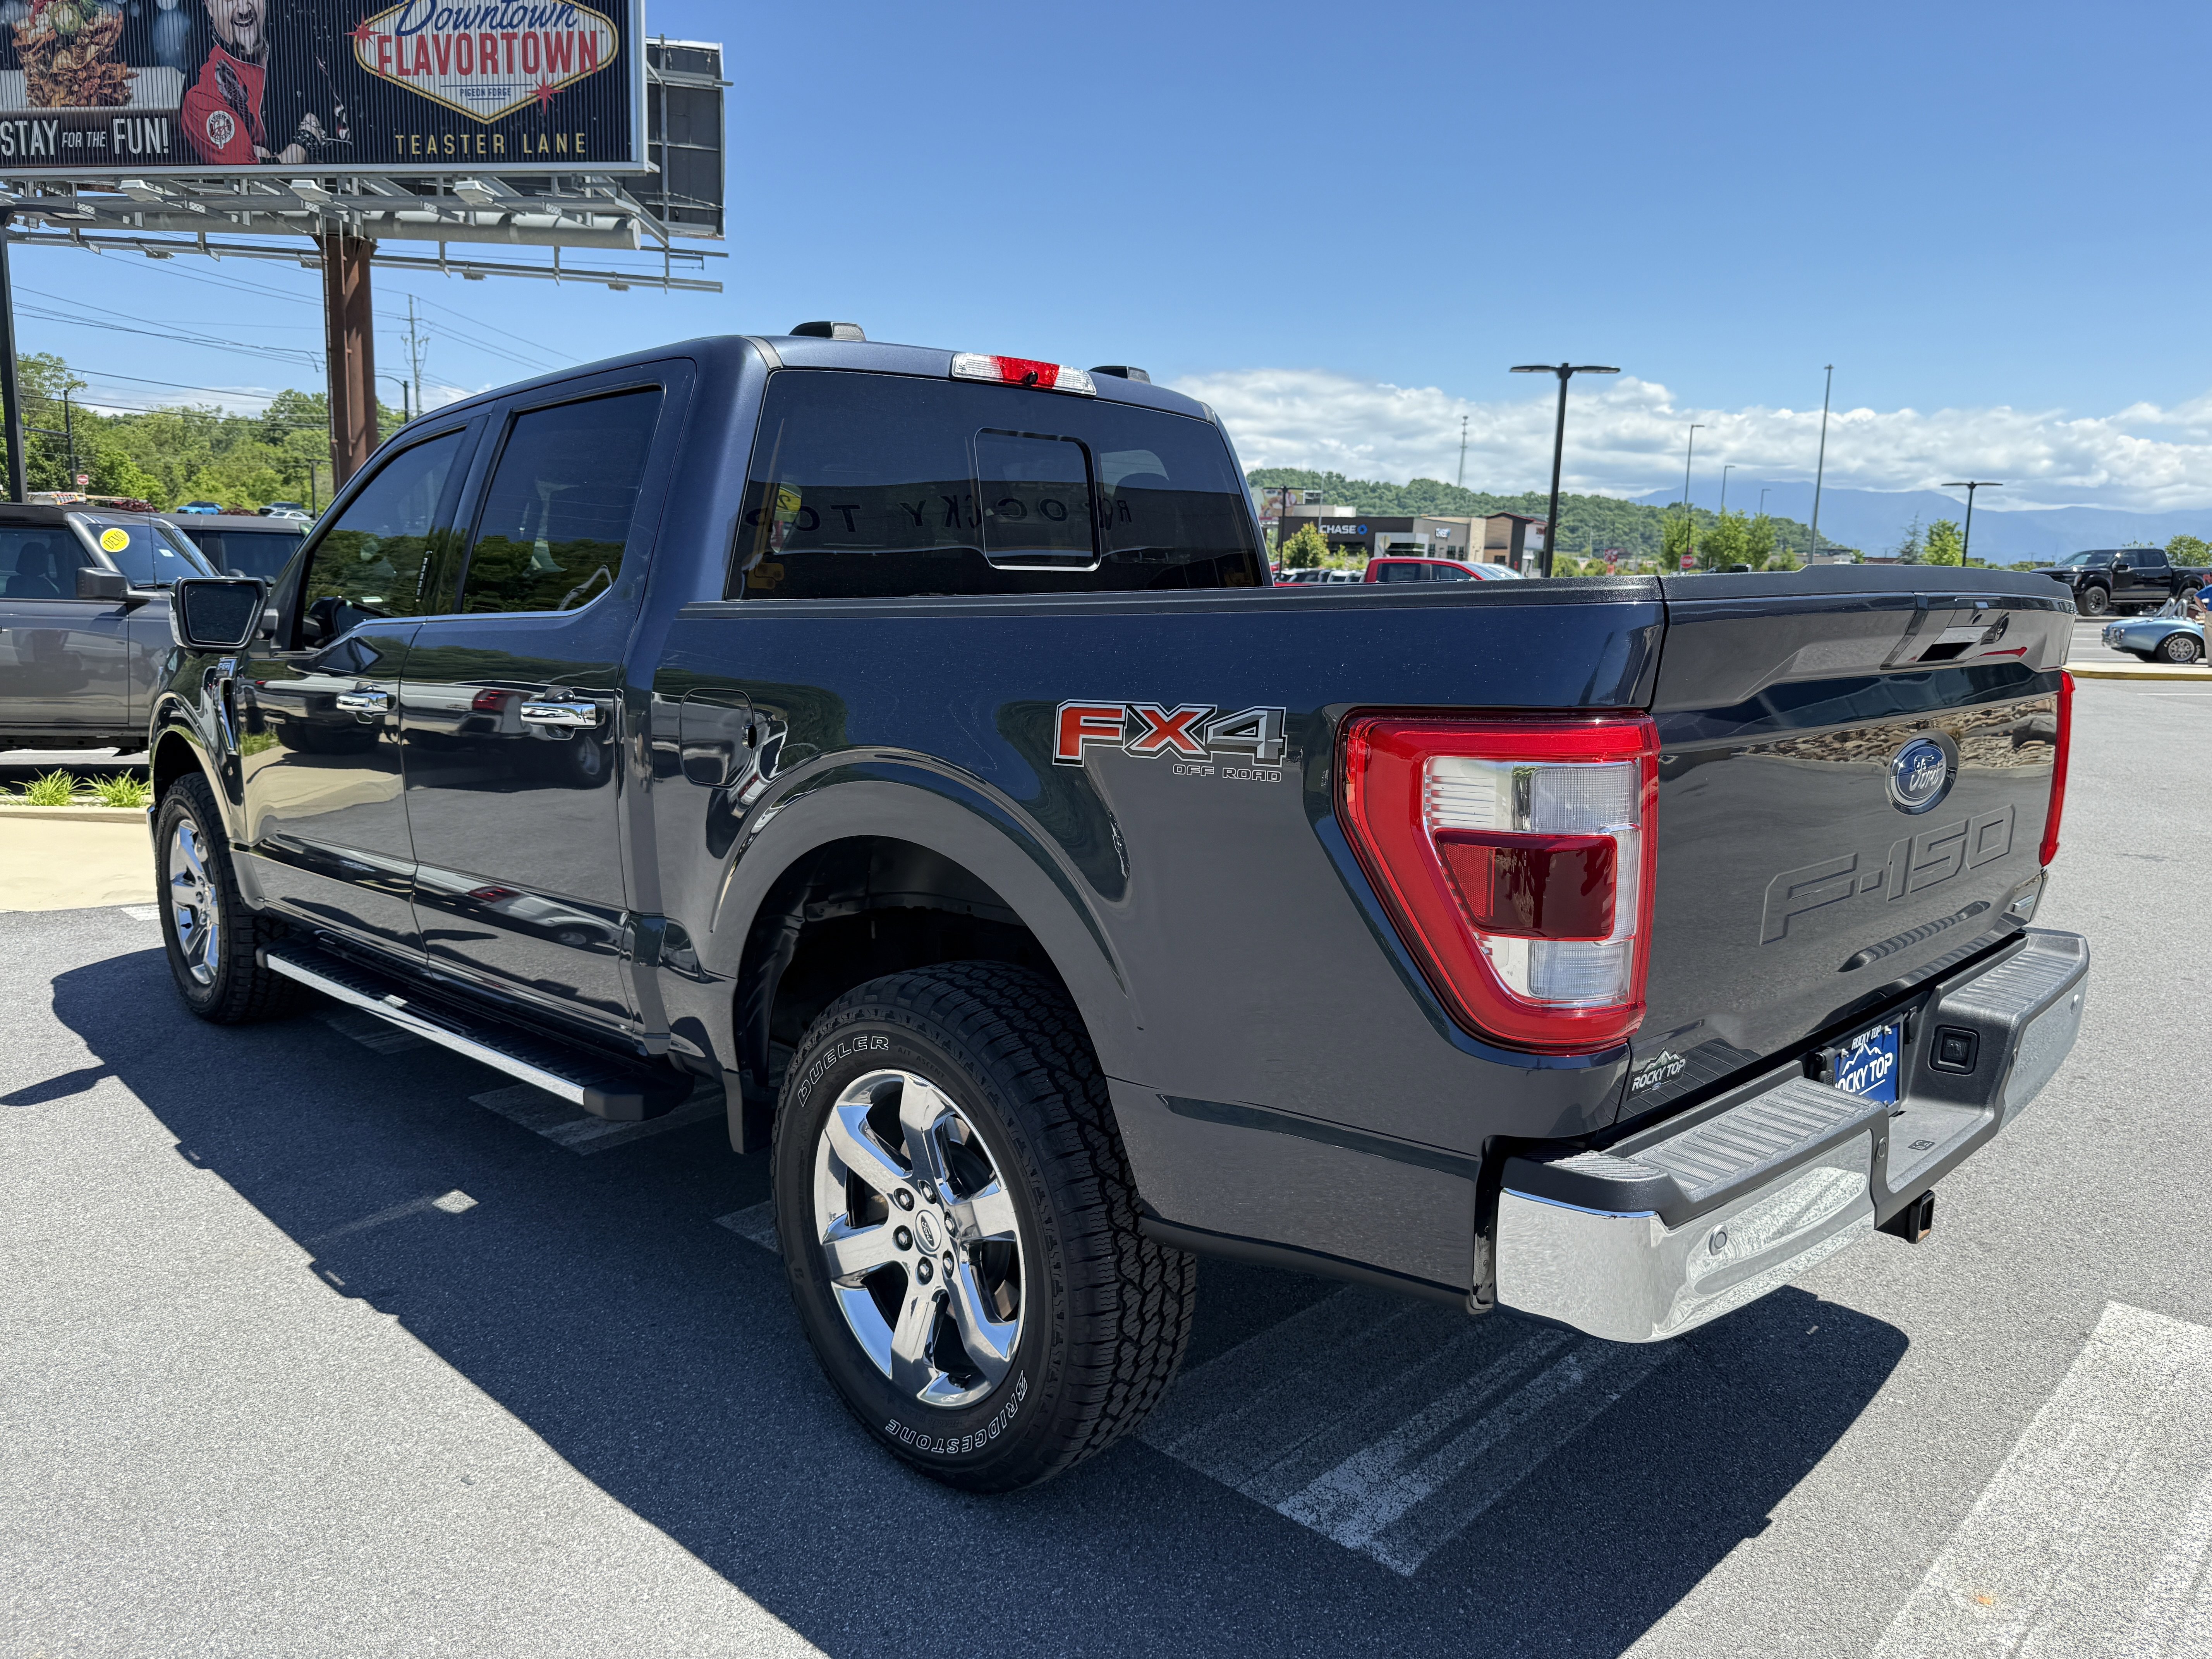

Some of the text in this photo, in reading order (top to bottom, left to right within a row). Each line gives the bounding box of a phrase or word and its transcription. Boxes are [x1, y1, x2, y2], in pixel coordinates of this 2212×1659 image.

[396, 0, 577, 36] Downtown
[377, 30, 598, 76] FLAVORTOWN
[460, 87, 511, 97] PIGEON FORGE
[0, 118, 169, 156] STAY FOR THE FUN!
[395, 133, 586, 155] TEASTER LANE
[102, 531, 126, 549] DEMO
[1320, 525, 1357, 534] CHASE
[1053, 699, 1288, 768] FX4
[1173, 764, 1282, 782] OFF ROAD
[1909, 754, 1942, 791] Ford
[1759, 804, 2015, 946] F-150
[1851, 1024, 1882, 1050] ROCKY TOP
[797, 1035, 946, 1108] DUELER A/T ASCENT
[1632, 1058, 1686, 1091] ROCKY TOP
[1835, 1052, 1893, 1093] OCKY TOP
[884, 1369, 1028, 1454] BRIDGESTONE
